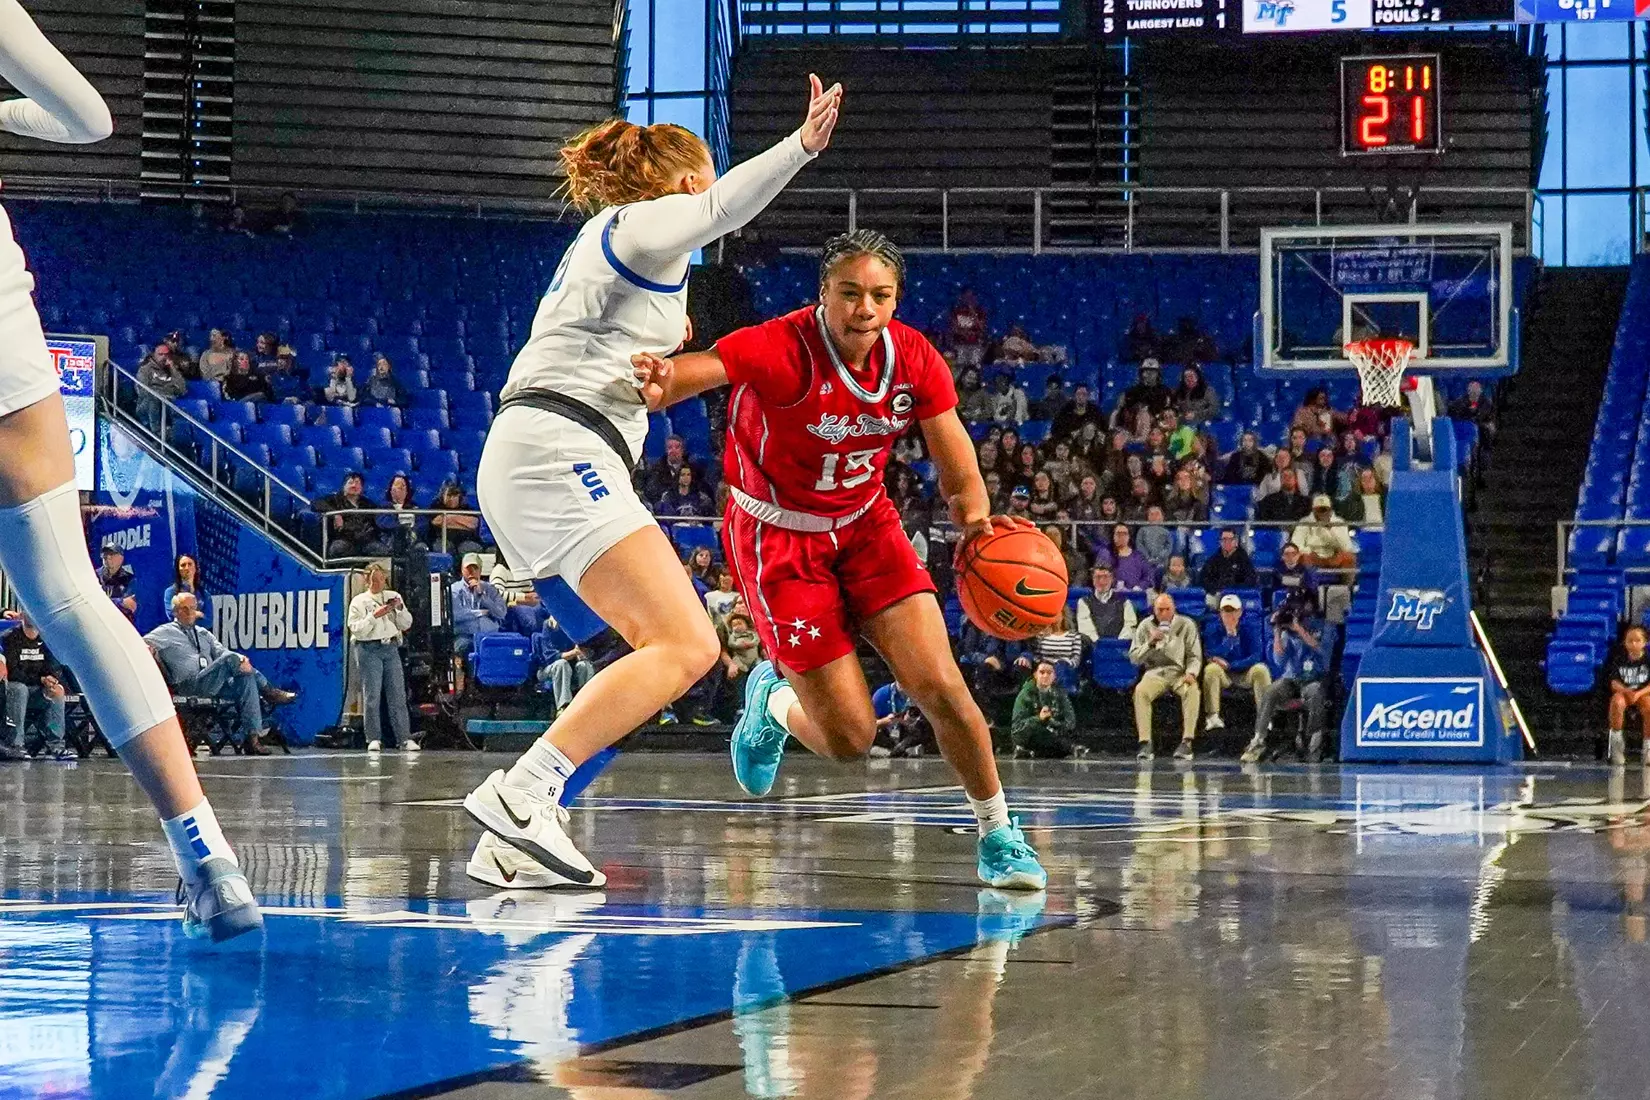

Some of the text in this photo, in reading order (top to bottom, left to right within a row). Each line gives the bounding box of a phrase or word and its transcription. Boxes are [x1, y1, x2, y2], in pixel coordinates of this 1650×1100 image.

[1103, 0, 1114, 13] 2
[1126, 0, 1204, 11] TURNOVERS
[1331, 0, 1346, 23] 5
[1375, 10, 1420, 23] FOULS
[1431, 9, 1440, 22] 2
[1575, 9, 1597, 20] 1ST
[1103, 12, 1226, 33] 3 LARGEST LEAD 1
[1369, 65, 1430, 93] 8:11
[1362, 95, 1424, 143] 21
[807, 412, 850, 444] Lady
[211, 589, 331, 650] TRUEBLUE
[992, 607, 1046, 632] ELIT
[1386, 592, 1446, 631] MT
[1363, 702, 1475, 729] Ascend
[1361, 729, 1471, 740] Federal Credit Union
